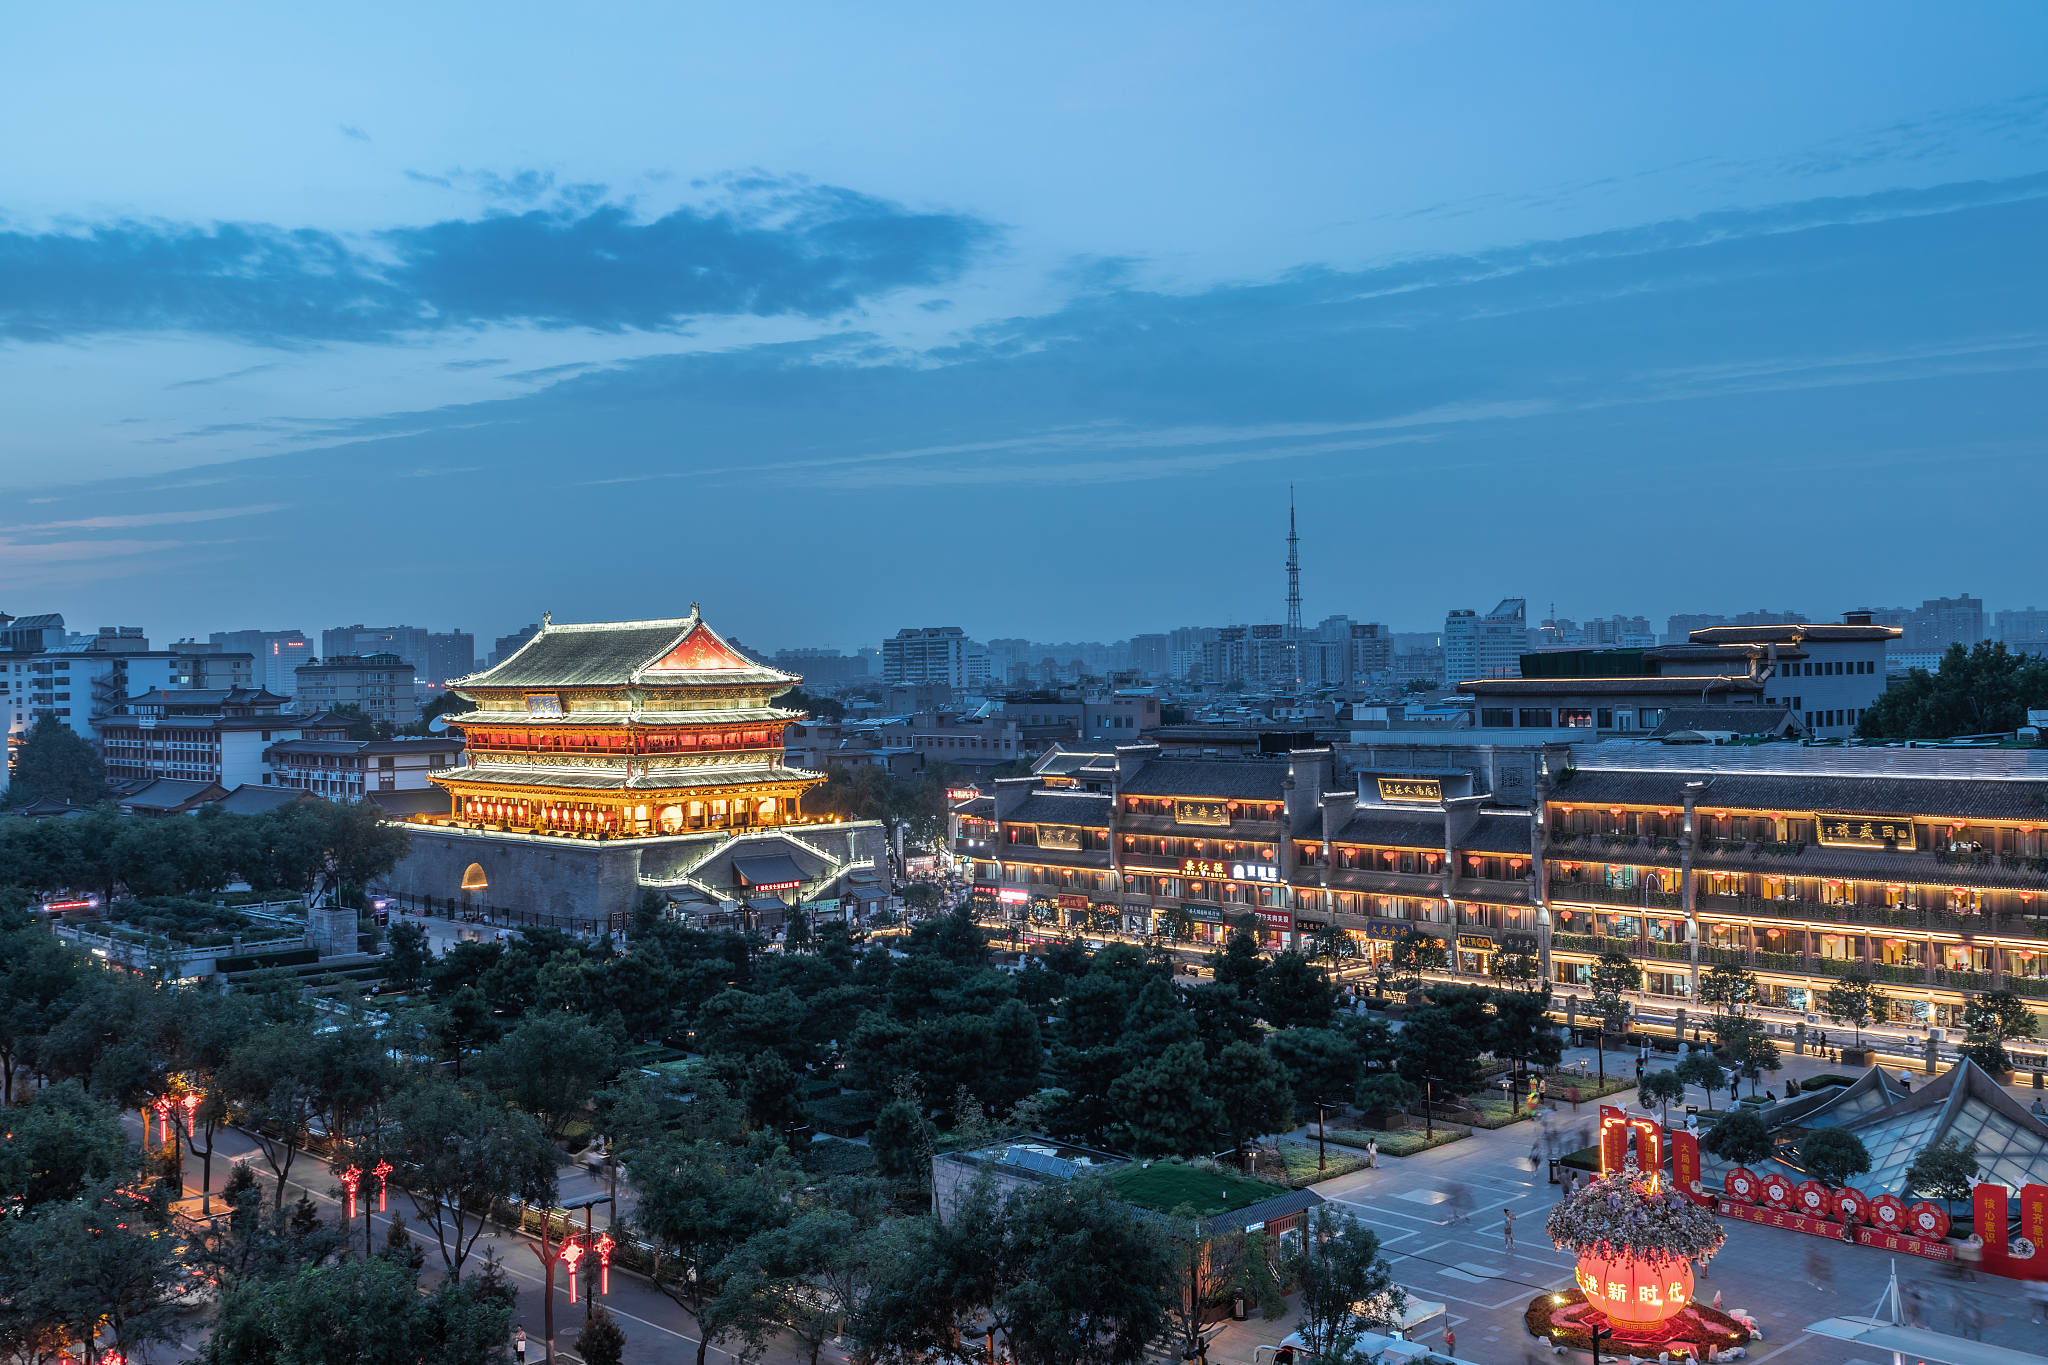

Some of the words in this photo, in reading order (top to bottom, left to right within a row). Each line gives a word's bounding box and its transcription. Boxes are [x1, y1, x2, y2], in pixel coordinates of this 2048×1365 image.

[1680, 1143, 1691, 1185] 大局意识
[1983, 1197, 1996, 1244] 核心意识
[2031, 1201, 2045, 1249] 看齐意识
